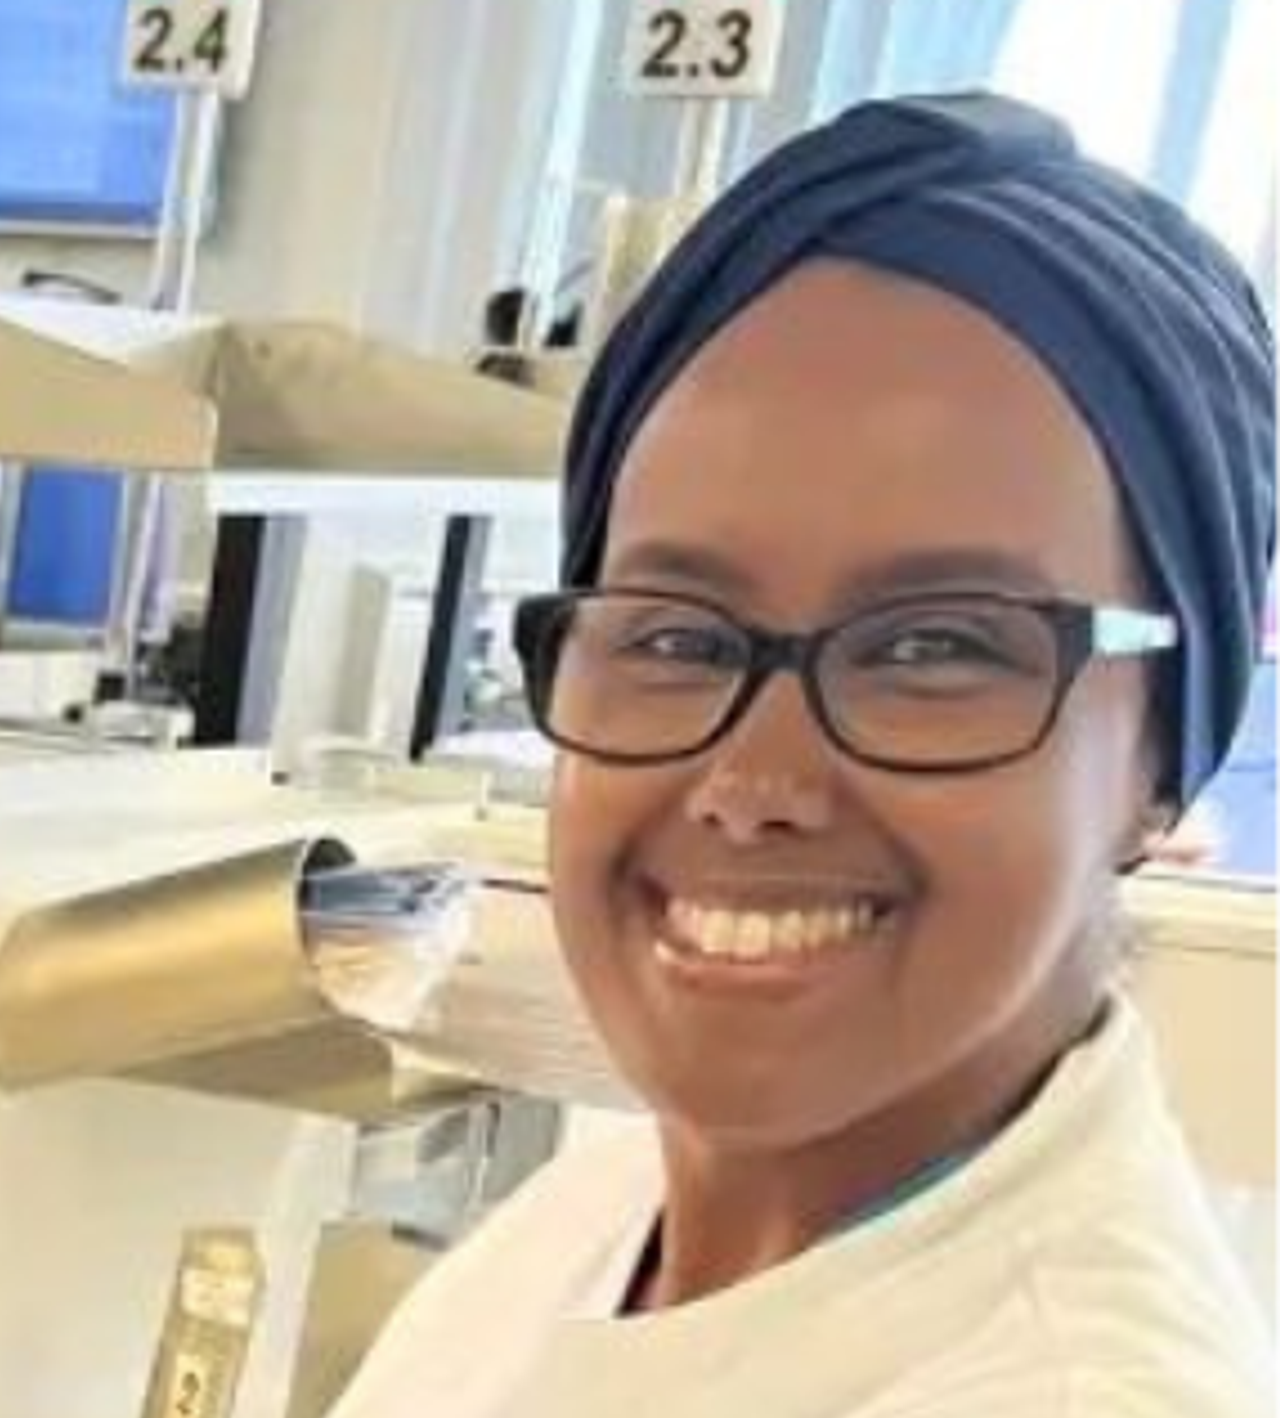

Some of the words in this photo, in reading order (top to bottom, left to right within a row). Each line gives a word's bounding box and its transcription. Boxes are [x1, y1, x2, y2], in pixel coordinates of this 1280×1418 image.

[132, 6, 228, 72] 2.4
[641, 8, 752, 78] 2.3
[175, 1372, 200, 1416] 2
